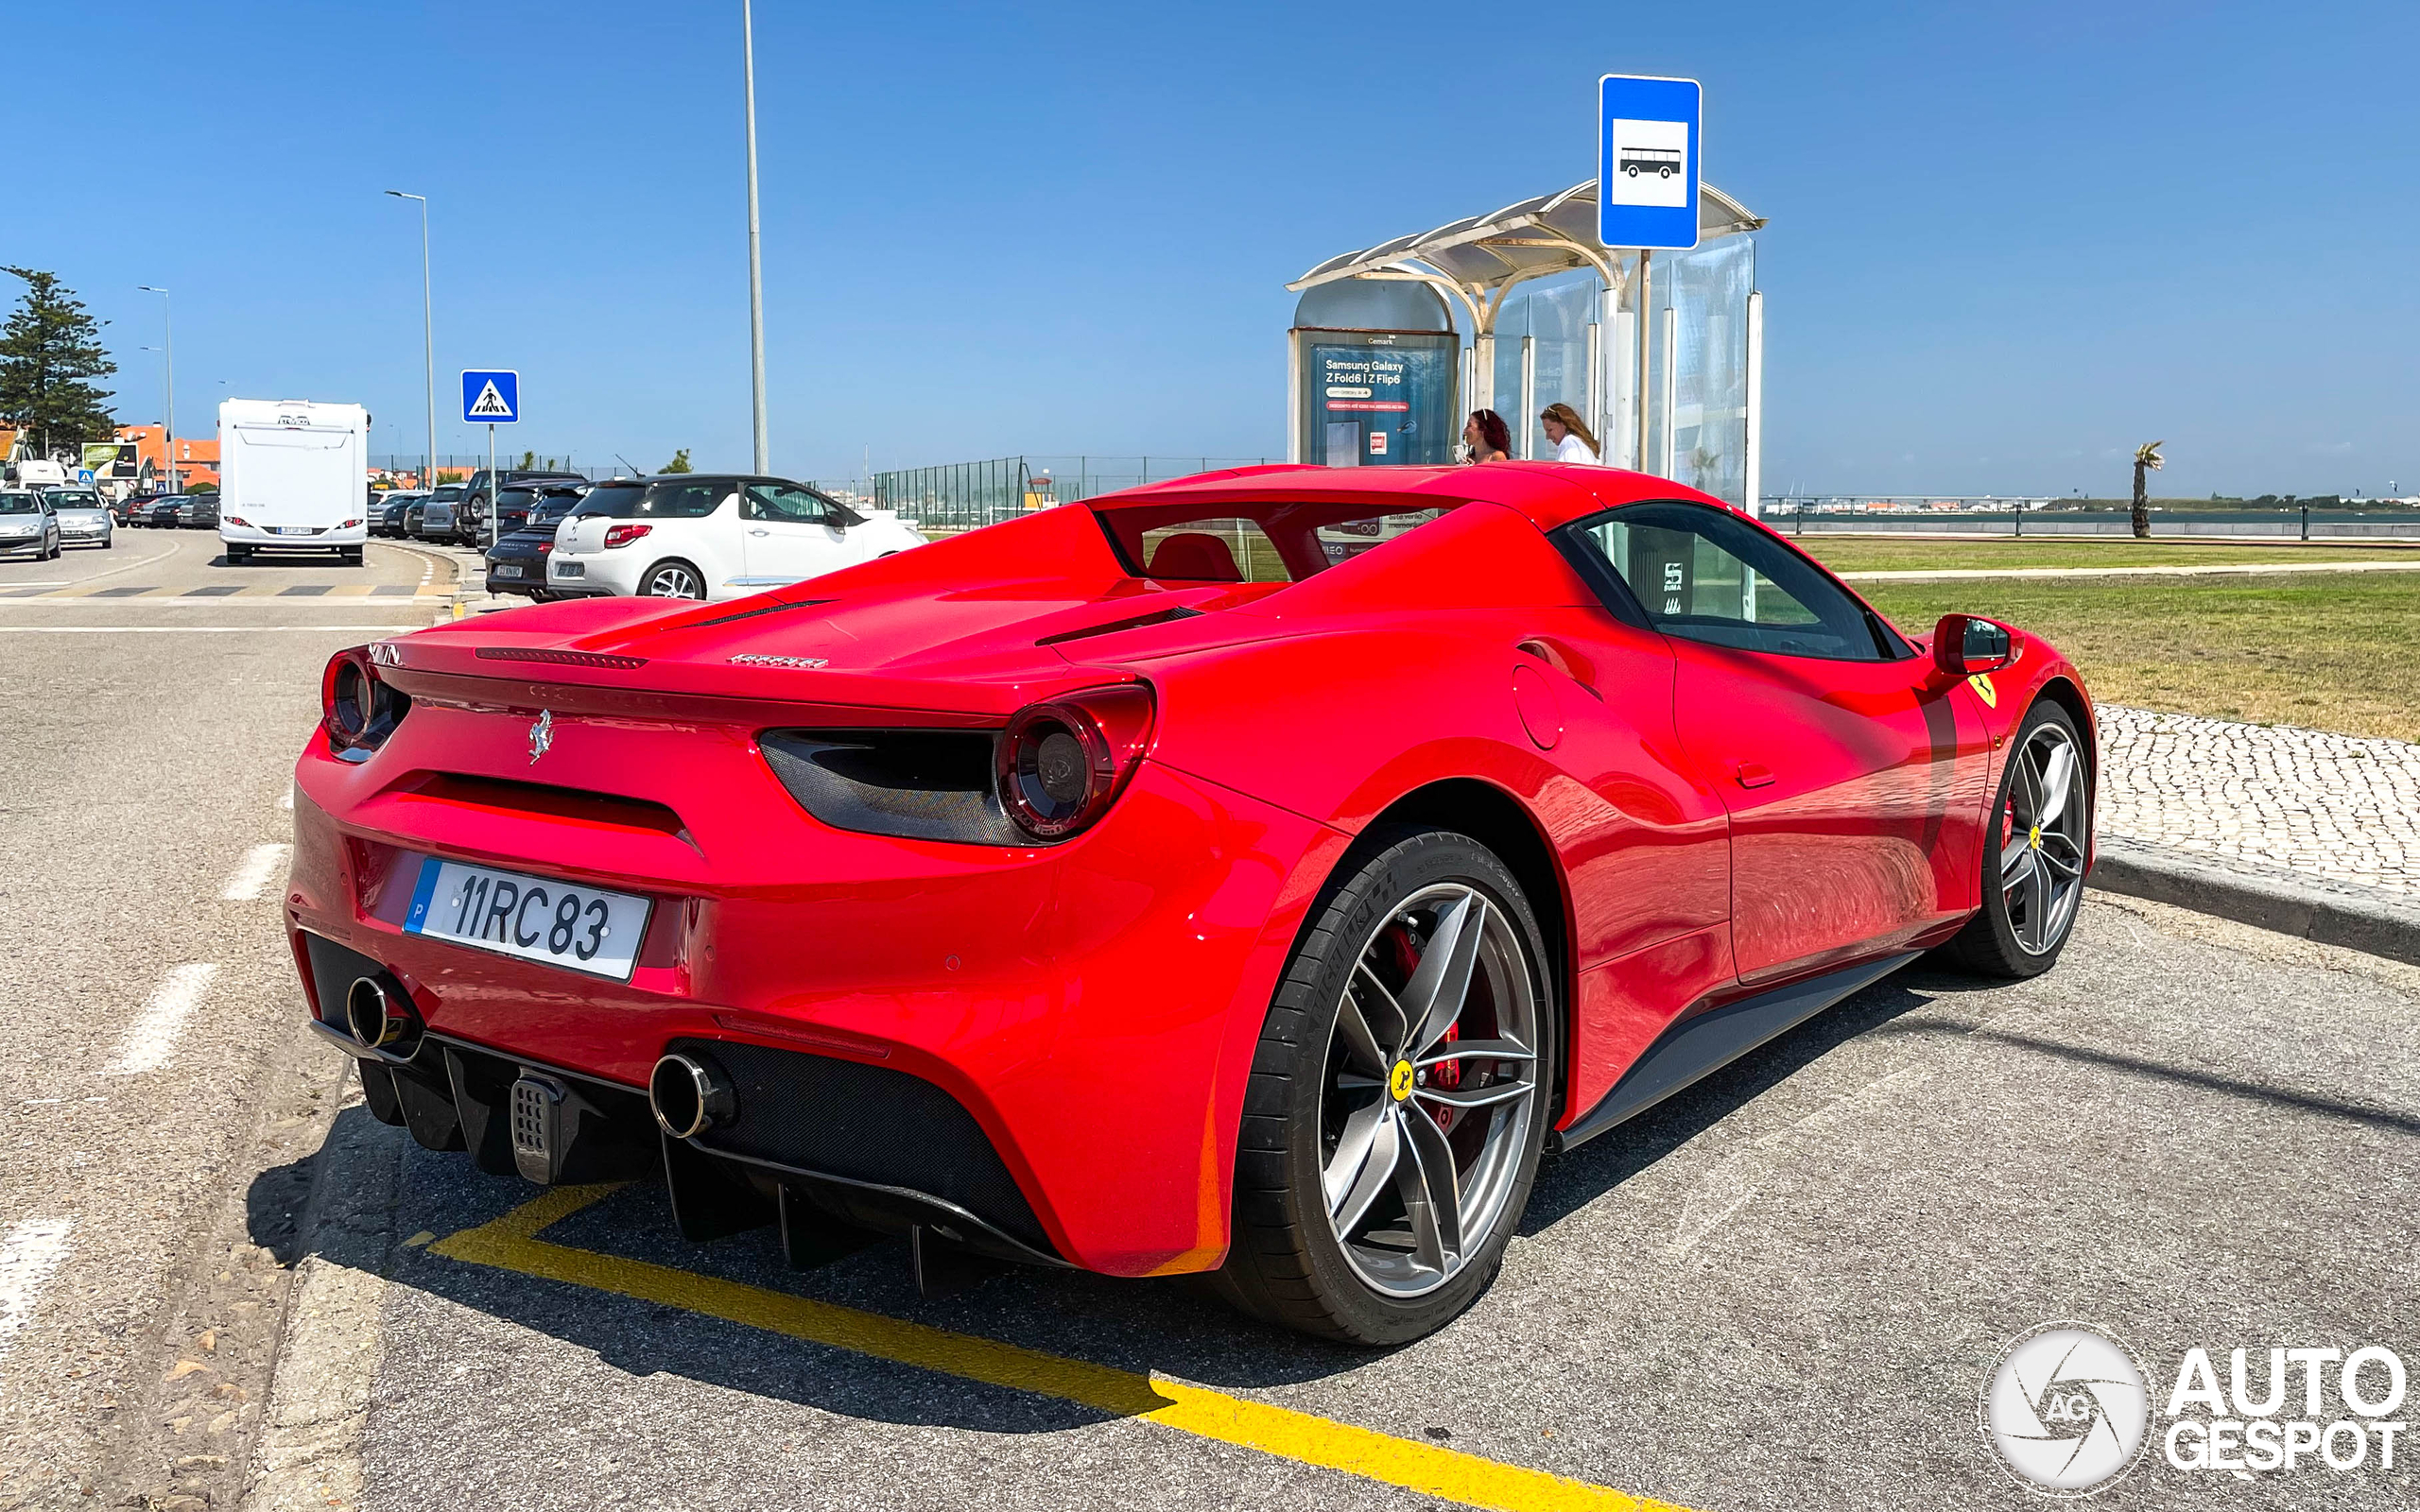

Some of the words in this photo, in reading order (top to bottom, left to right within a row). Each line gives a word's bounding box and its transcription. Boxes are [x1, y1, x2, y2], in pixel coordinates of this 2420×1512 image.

[1368, 337, 1393, 346] Cemark
[1326, 360, 1370, 372] Samsung
[1372, 361, 1404, 373] Galaxy
[1325, 372, 1333, 383] Z
[1334, 373, 1361, 383] Fold6
[1368, 374, 1375, 384] Z
[1376, 373, 1401, 386] Flip6
[1664, 584, 1682, 593] SUMA
[412, 903, 424, 919] P
[1311, 898, 1375, 1025] MICHELIN
